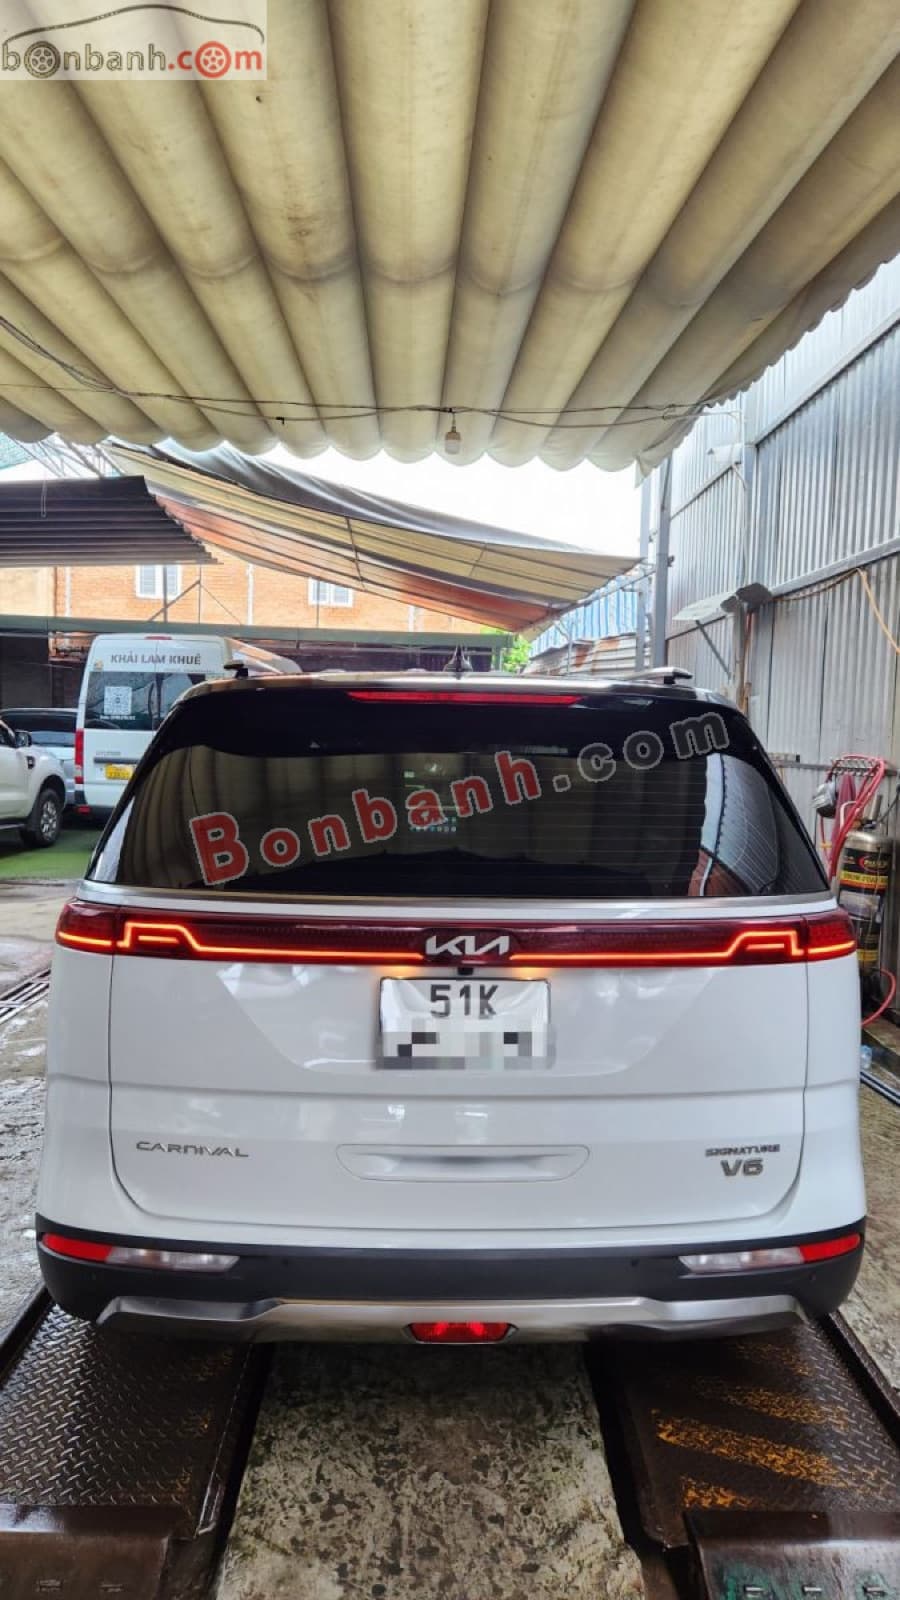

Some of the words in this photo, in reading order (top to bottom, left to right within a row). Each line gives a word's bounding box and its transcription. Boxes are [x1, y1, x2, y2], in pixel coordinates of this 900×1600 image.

[425, 935, 510, 956] KIA
[430, 984, 499, 1019] 51K
[136, 1141, 249, 1158] CARNIVAL
[705, 1143, 781, 1157] SIGNATURE
[720, 1158, 764, 1177] V6
